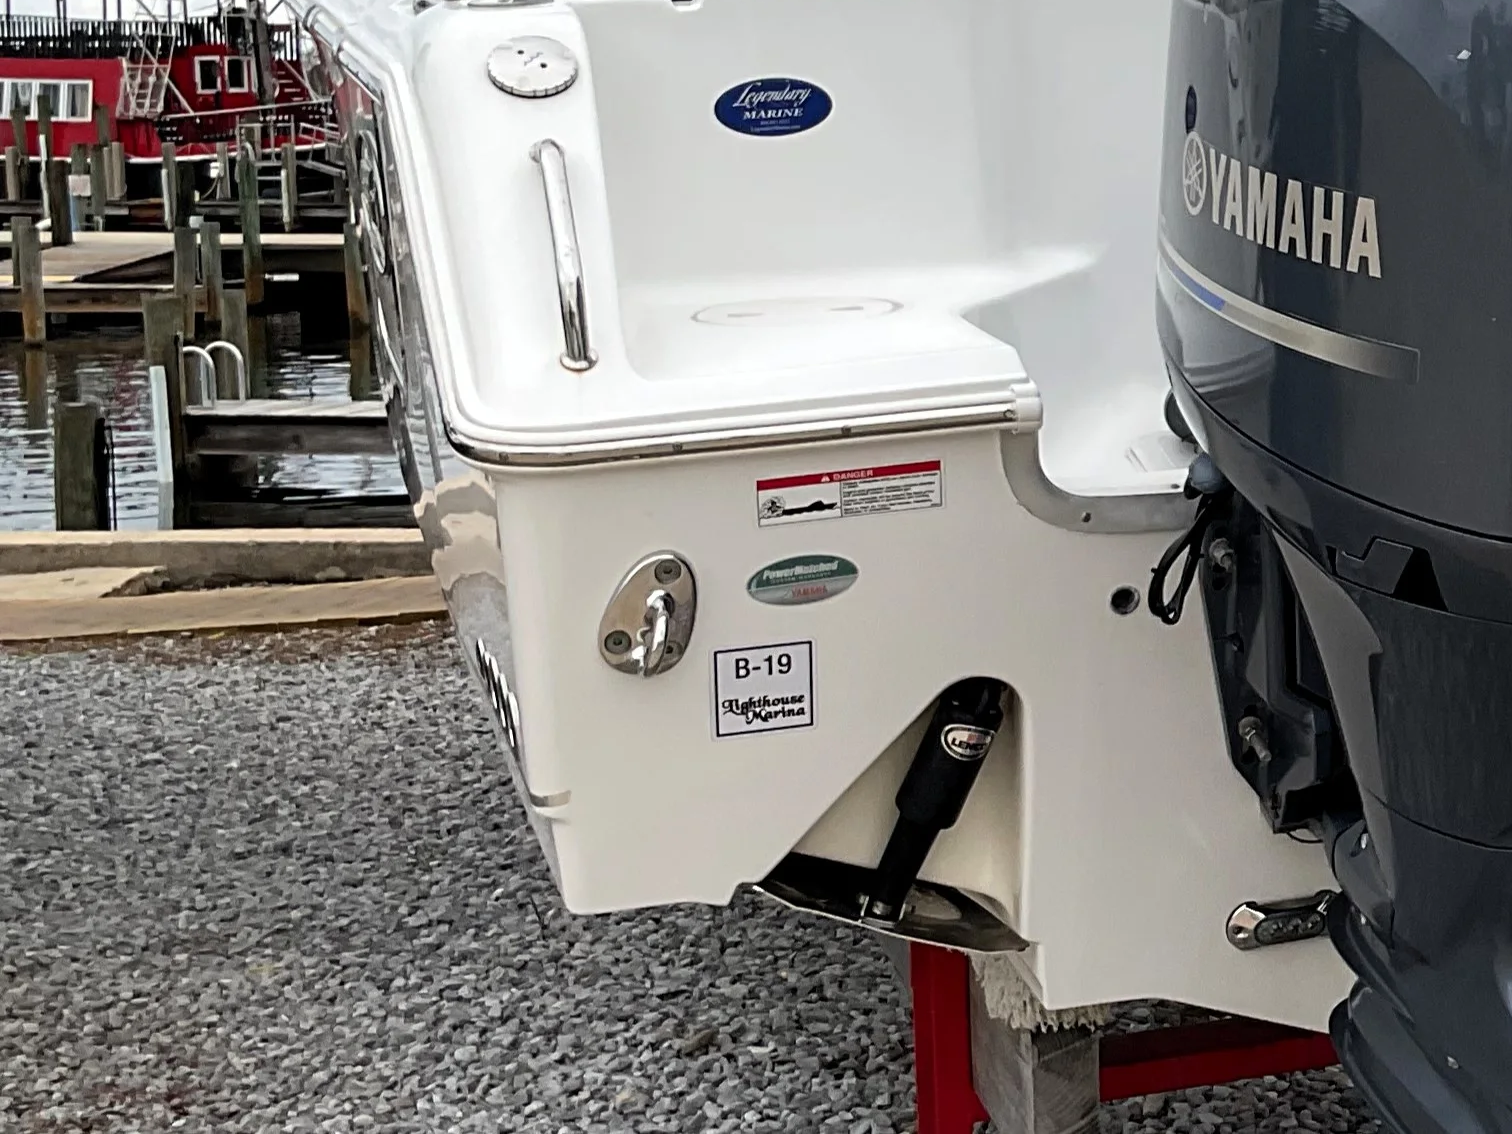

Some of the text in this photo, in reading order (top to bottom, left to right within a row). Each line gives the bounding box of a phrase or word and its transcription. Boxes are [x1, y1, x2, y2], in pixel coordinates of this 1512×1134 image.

[732, 81, 812, 108] Legendary
[743, 107, 803, 120] MARINE
[1209, 147, 1382, 279] YAMAHA
[833, 470, 874, 481] DANGER
[735, 653, 792, 679] B-19
[721, 695, 805, 716] Lighthouse
[745, 707, 806, 725] Marina
